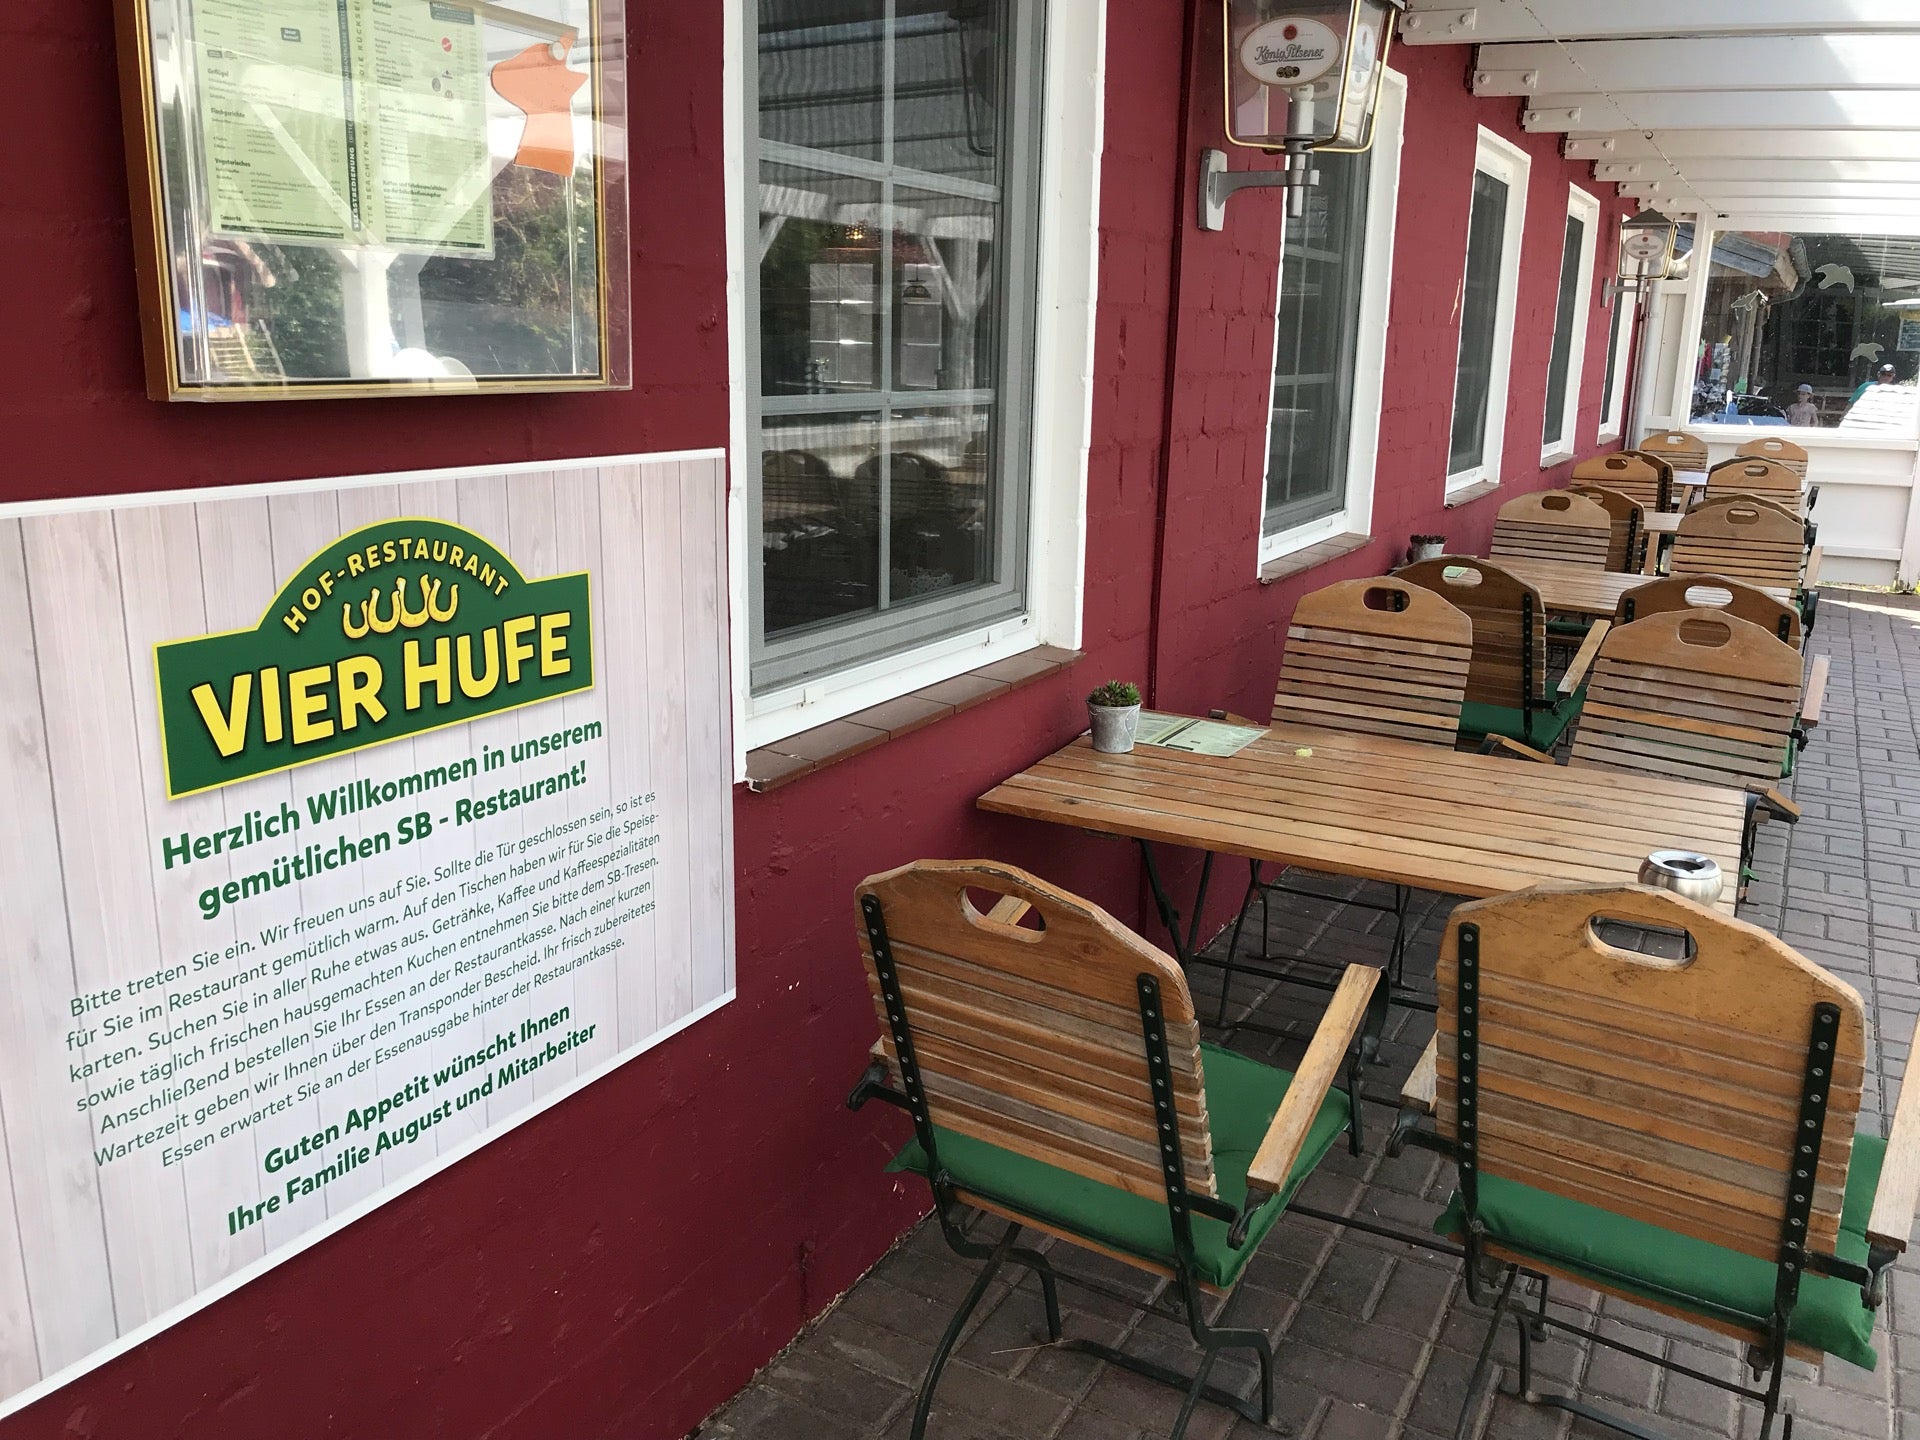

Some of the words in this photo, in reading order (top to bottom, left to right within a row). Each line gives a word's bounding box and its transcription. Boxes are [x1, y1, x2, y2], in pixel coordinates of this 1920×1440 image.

[1254, 45, 1286, 62] König
[1284, 43, 1325, 60] Pilsener
[349, 147, 360, 229] SELBSTBEDIENUNG
[363, 141, 372, 200] BEACHTEN
[282, 536, 510, 634] HOF-RESTAURANT
[190, 654, 388, 758] VIER
[403, 610, 571, 711] HUFE
[162, 801, 300, 870] Herzlich
[306, 757, 478, 825] Willkommen
[483, 744, 505, 773] in
[510, 720, 602, 764] unserem
[198, 831, 391, 921] gemütlichen
[397, 811, 433, 845] SB
[439, 816, 449, 825] -
[455, 759, 587, 827] Restaurant!
[65, 1027, 96, 1051] für
[103, 1015, 133, 1037] Sie
[139, 1005, 163, 1024] im
[170, 962, 268, 1012] Restaurant
[272, 928, 350, 976] gemütlich
[354, 915, 399, 939] warm.
[403, 896, 428, 921] Auf
[431, 891, 456, 909] den
[458, 872, 507, 898] Tischen
[509, 856, 546, 879] haben
[548, 846, 566, 863] wir
[568, 839, 585, 856] für
[586, 832, 603, 848] Sie
[605, 825, 621, 841] die
[624, 814, 660, 835] Speise-
[69, 1046, 143, 1084] karten.
[148, 1014, 217, 1051] Suchen
[222, 1001, 248, 1020] Sie
[253, 993, 268, 1009] in
[273, 977, 307, 1000] aller
[311, 960, 350, 985] Ruhe
[354, 940, 398, 967] etwas
[401, 930, 429, 948] aus.
[432, 901, 494, 934] Getränke,
[497, 884, 536, 909] Kaffee
[538, 869, 560, 891] und
[563, 834, 660, 881] Kaffeespezialitäten
[70, 989, 121, 1018] Bitte
[126, 965, 187, 996] treten
[192, 952, 220, 972] Sie
[225, 940, 256, 960] ein.
[259, 924, 290, 946] Wir
[292, 907, 344, 935] freuen
[349, 895, 375, 914] uns
[379, 879, 403, 903] auf
[405, 875, 430, 893] Sie.
[434, 859, 471, 882] Sollte
[474, 850, 494, 867] die
[496, 841, 516, 859] Tür
[518, 817, 587, 854] geschlossen
[589, 806, 614, 824] sein,
[616, 802, 628, 814] so
[630, 795, 643, 809] ist
[645, 793, 655, 803] es
[76, 1077, 135, 1112] sowie
[139, 1045, 205, 1085] täglich
[209, 1018, 279, 1056] frischen
[283, 965, 403, 1025] hausgemachten
[407, 942, 456, 972] Kuchen
[460, 911, 529, 948] entnehmen
[532, 901, 550, 918] Sie
[552, 890, 579, 909] bitte
[581, 879, 605, 896] dem
[607, 853, 659, 886] SB-Tresen.
[93, 1113, 190, 1166] Wartezeit
[194, 1088, 249, 1126] geben
[254, 1072, 280, 1094] wir
[284, 1052, 328, 1081] Ihnen
[332, 1033, 366, 1058] über
[369, 1021, 396, 1041] den
[398, 980, 482, 1026] Transponder
[484, 950, 541, 988] Bescheid.
[544, 944, 559, 960] Ihr
[561, 927, 592, 952] frisch
[594, 900, 656, 936] zubereitetes
[101, 1062, 229, 1132] Anschließend
[234, 1033, 309, 1075] bestellen
[314, 1019, 337, 1039] Sie
[341, 1009, 361, 1028] Ihr
[365, 990, 406, 1017] Essen
[409, 981, 426, 997] an
[429, 969, 451, 987] der
[454, 924, 557, 977] Restaurantkasse.
[559, 906, 587, 930] Nach
[590, 896, 616, 915] einer
[617, 881, 651, 903] kurzen
[162, 1132, 215, 1168] Essen
[220, 1093, 294, 1139] erwartet
[297, 1082, 321, 1101] Sie
[325, 1072, 343, 1089] an
[347, 1058, 371, 1078] der
[375, 1011, 470, 1065] Essenausgabe
[472, 992, 509, 1018] hinter
[511, 981, 531, 998] der
[534, 938, 625, 988] Restaurantkasse.
[264, 1124, 340, 1174] Guten
[344, 1075, 430, 1135] Appetit
[433, 1030, 517, 1088] wünscht
[520, 1006, 570, 1043] Ihnen
[228, 1195, 281, 1236] Ihre
[286, 1146, 370, 1205] Familie
[374, 1099, 452, 1157] August
[456, 1072, 493, 1111] und
[497, 1023, 596, 1090] Mitarbeiter
